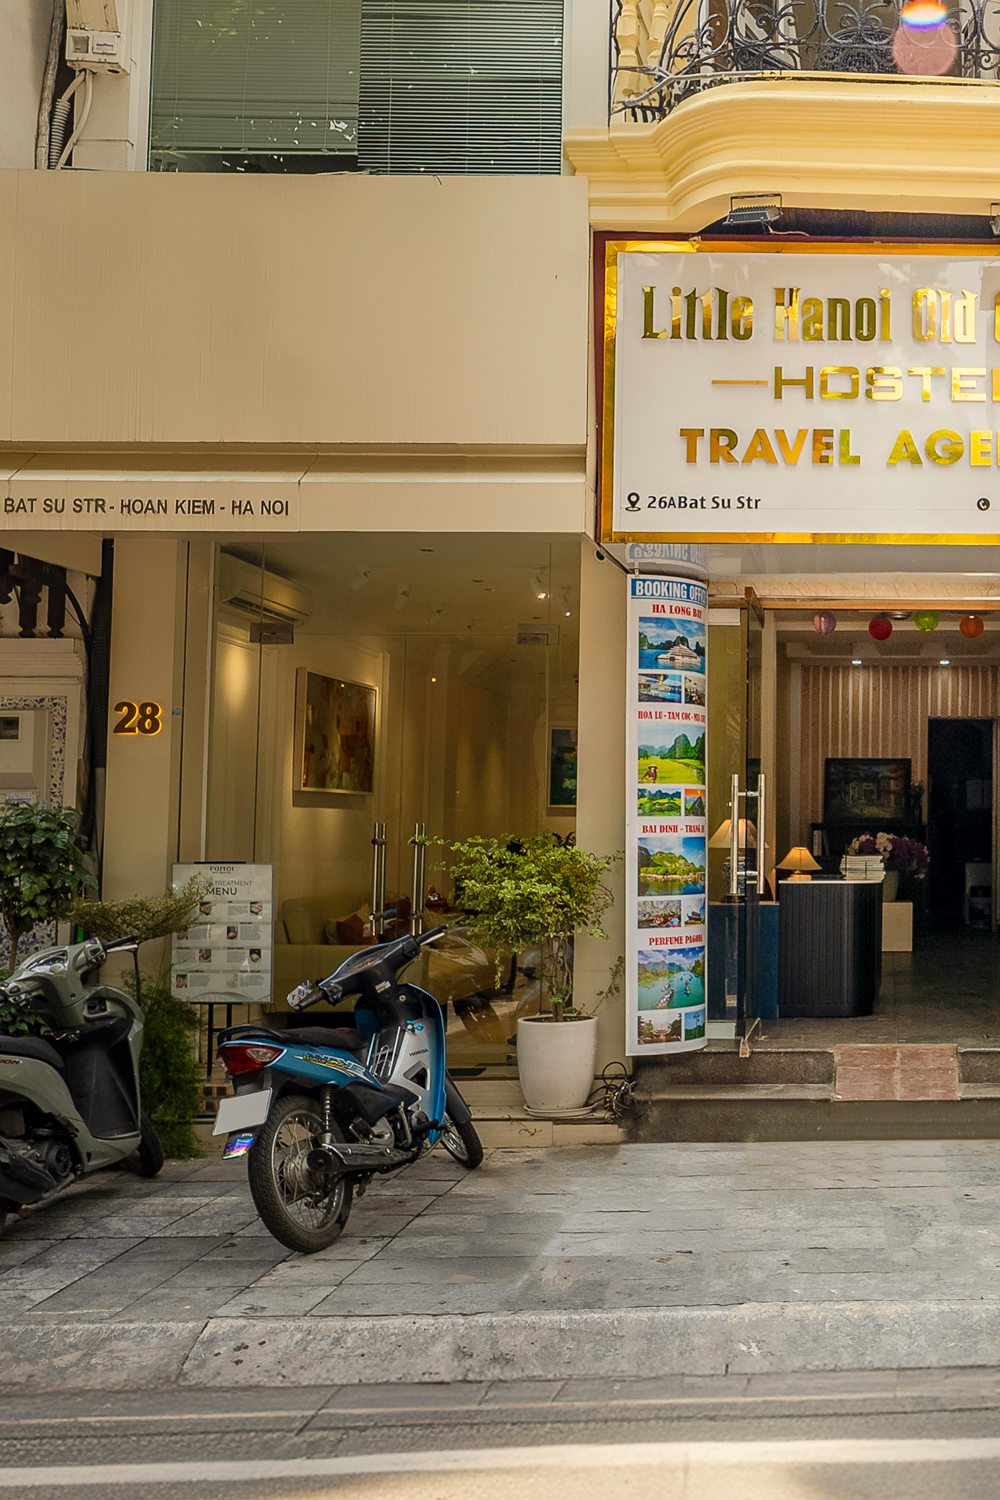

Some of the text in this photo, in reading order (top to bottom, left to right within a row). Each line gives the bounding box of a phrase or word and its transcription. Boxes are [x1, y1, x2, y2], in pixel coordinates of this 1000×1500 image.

[641, 286, 754, 341] Little
[772, 287, 893, 342] Hanoi
[912, 288, 979, 344] Old
[679, 428, 862, 465] TRAVEL
[3, 497, 38, 514] BAT
[42, 498, 66, 514] SU
[120, 499, 168, 515] HOAN
[175, 499, 216, 515] KIEM
[231, 500, 255, 515] HA
[261, 500, 289, 516] NOI
[711, 495, 732, 509] Su
[736, 495, 762, 509] Str
[635, 580, 688, 599] BOOKING
[652, 604, 666, 614] HA
[669, 605, 691, 616] LONG
[113, 701, 162, 736] 28
[637, 710, 653, 719] HOA
[655, 710, 663, 719] LU
[642, 824, 657, 834] BAI
[659, 824, 679, 833] DINH
[207, 887, 238, 896] MENU
[648, 935, 684, 946] PERFUME
[408, 1048, 430, 1057] HONDA
